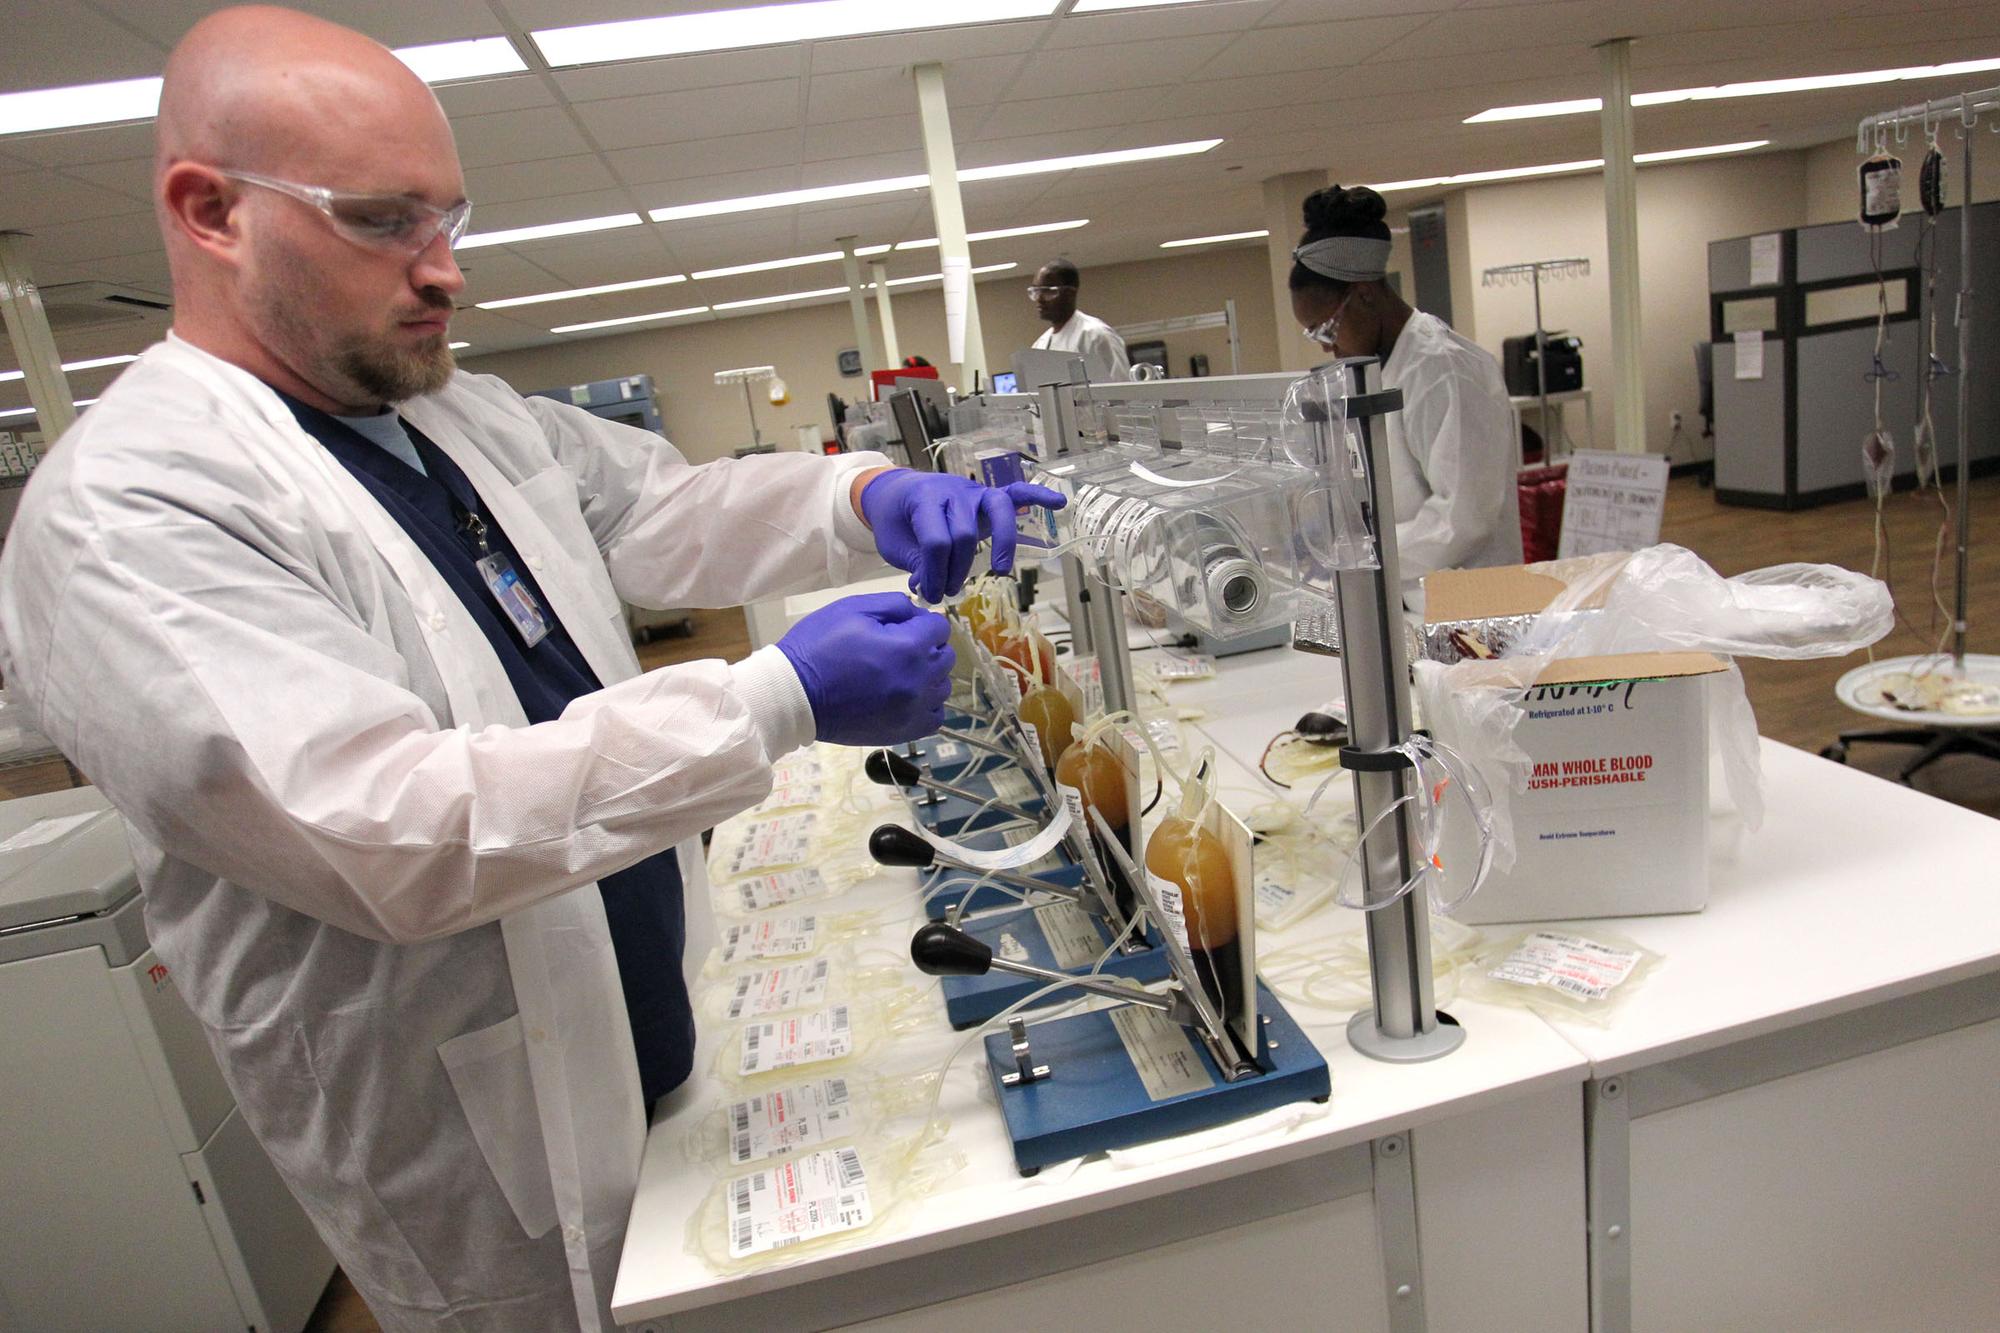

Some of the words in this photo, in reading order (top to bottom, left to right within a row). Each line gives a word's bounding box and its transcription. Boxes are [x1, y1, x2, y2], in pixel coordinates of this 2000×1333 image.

[1529, 706, 1575, 719] Refrigerated
[1577, 705, 1585, 716] at
[1531, 762, 1559, 778] MAN
[1562, 758, 1607, 775] WHOLE
[1611, 755, 1653, 771] BLOOD
